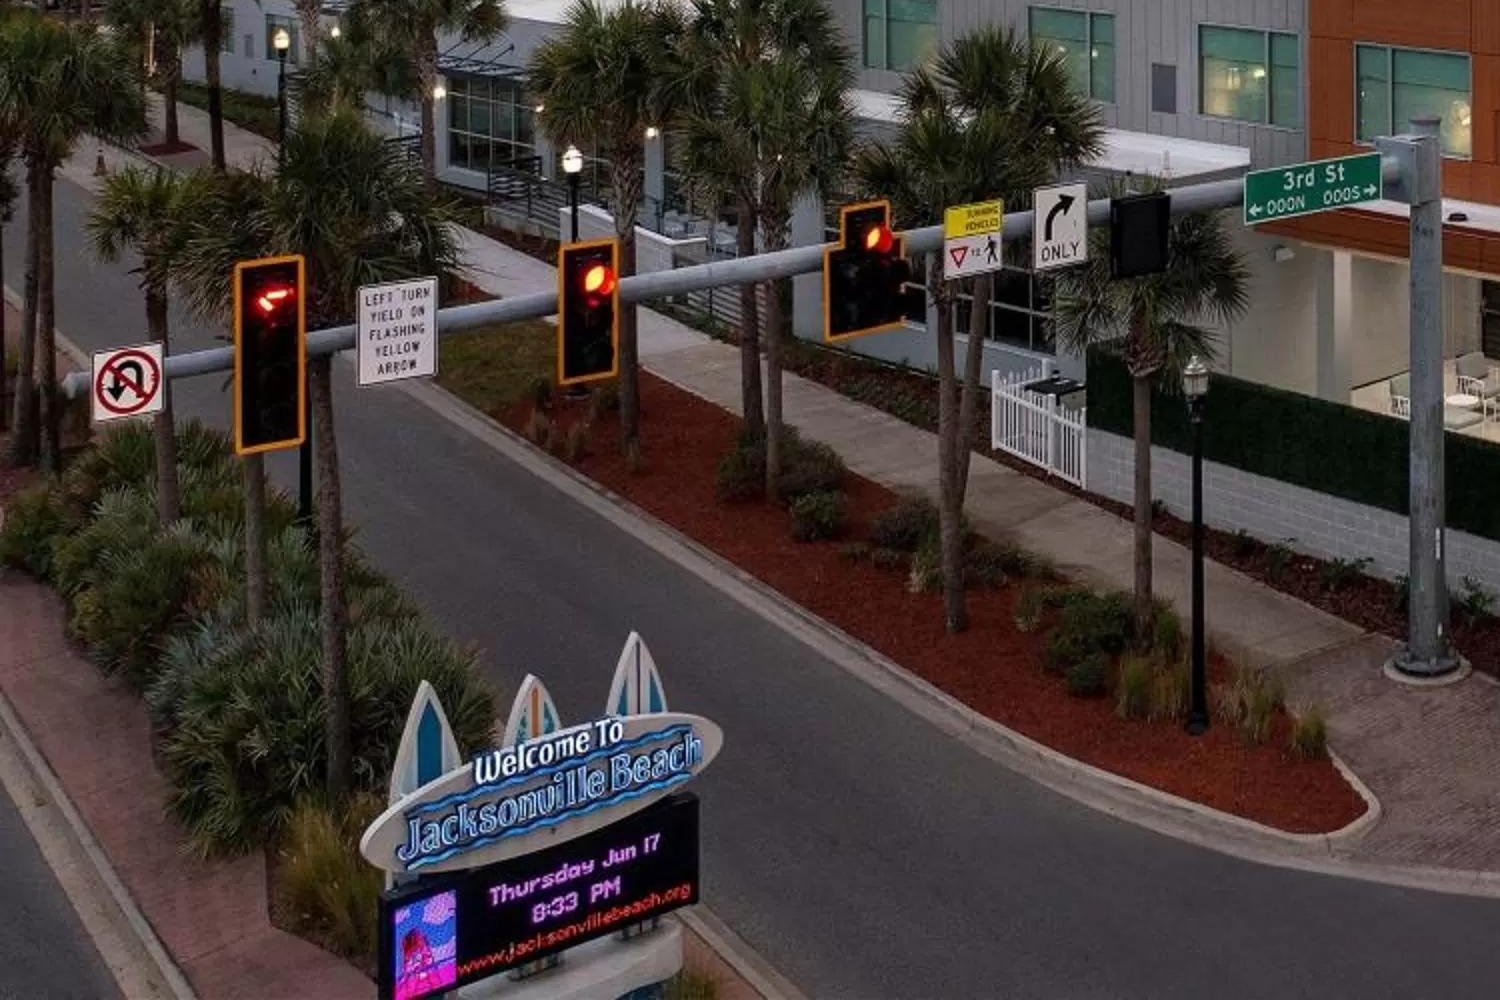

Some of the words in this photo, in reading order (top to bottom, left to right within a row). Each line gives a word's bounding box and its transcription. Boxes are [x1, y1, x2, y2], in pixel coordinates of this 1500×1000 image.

[1283, 168, 1315, 191] 3rd
[1325, 162, 1345, 183] St
[1266, 195, 1305, 215] 000N
[1323, 185, 1361, 205] 000S
[1041, 241, 1080, 262] ONLY
[365, 291, 393, 307] LEFT
[401, 287, 430, 301] TURN
[370, 308, 403, 322] YIELD
[411, 305, 425, 318] ON
[369, 323, 425, 341] FLASHING
[375, 341, 420, 357] YELLOW
[378, 359, 417, 375] ARROW
[475, 731, 590, 785] Welcome
[595, 719, 623, 747] To
[397, 766, 605, 861] Jacksonville
[610, 732, 702, 792] Beach
[488, 858, 595, 907] Thursday
[602, 844, 637, 868] Jun
[643, 832, 662, 854] 17
[531, 890, 579, 924] 8:33
[591, 875, 622, 904] PM
[457, 882, 692, 977] www.jacksonvillebeach.org
